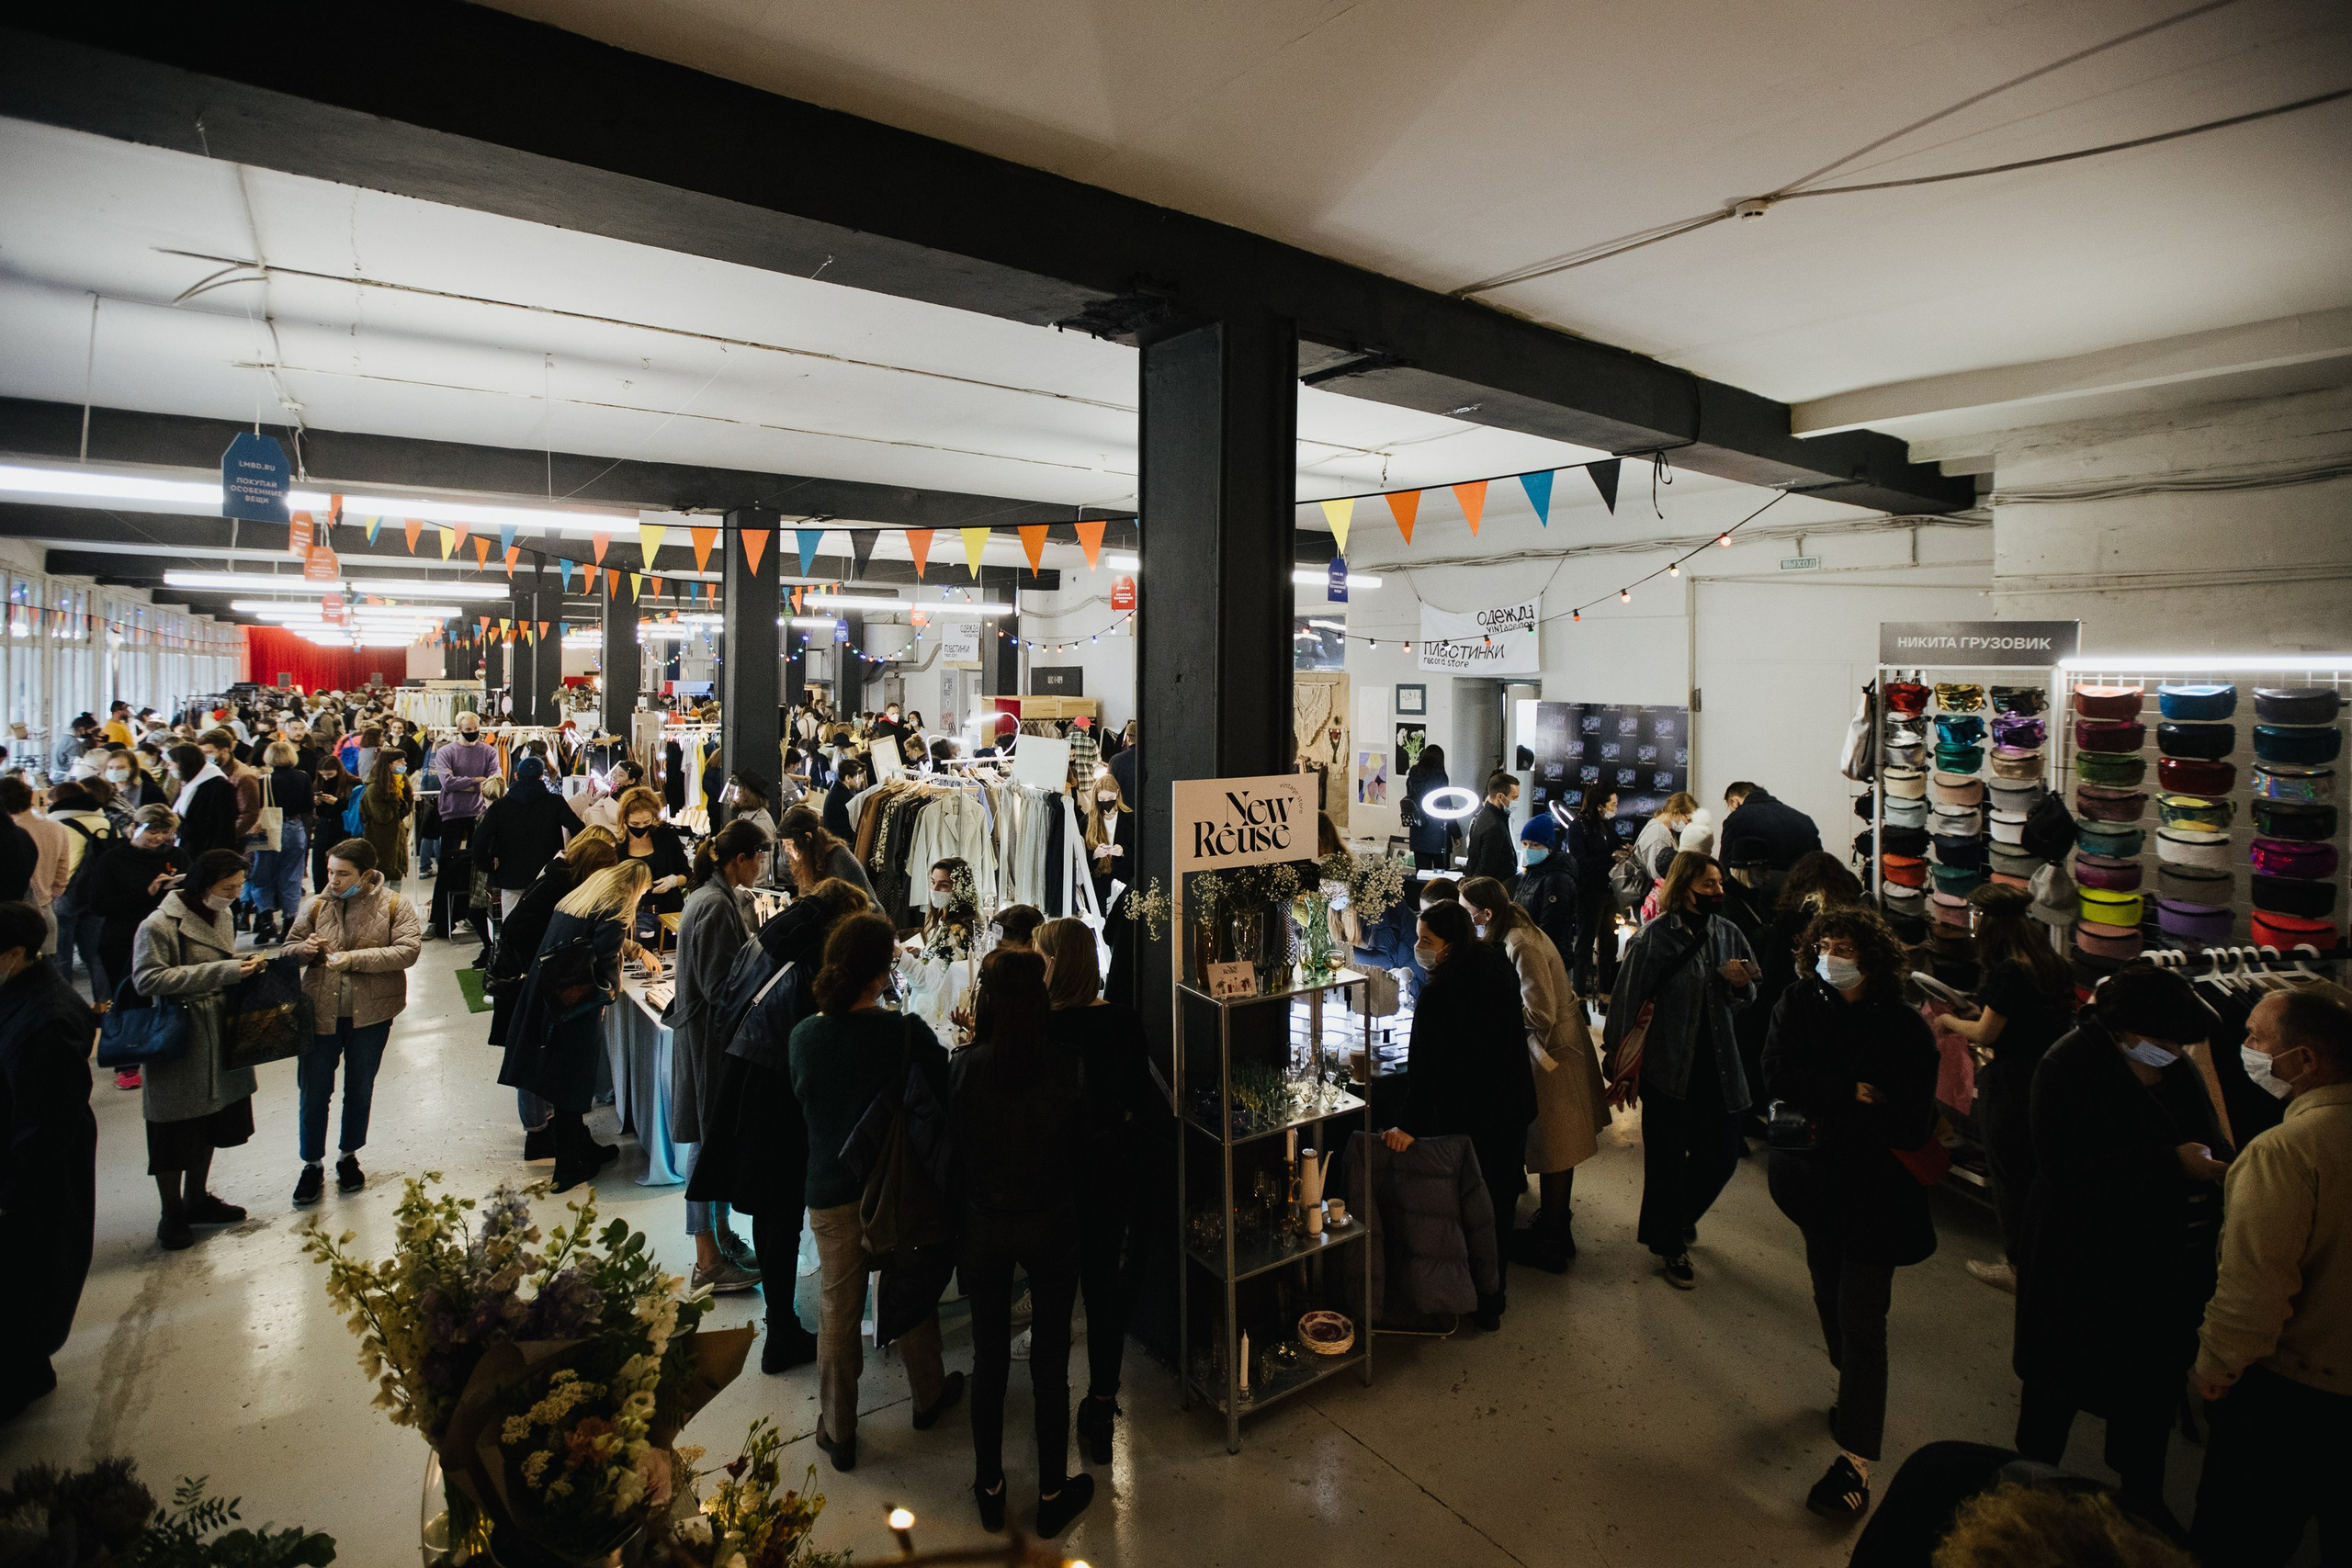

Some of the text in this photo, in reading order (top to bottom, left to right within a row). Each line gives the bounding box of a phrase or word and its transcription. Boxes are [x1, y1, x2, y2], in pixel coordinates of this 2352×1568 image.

[239, 460, 276, 471] LMBD.RU
[236, 478, 277, 488] ПОКУПАЙ
[230, 485, 284, 497] ОСОБЕННЫЕ
[244, 495, 269, 503] ВЕЩИ
[1782, 559, 1815, 569] ВЫХОД
[1898, 637, 2052, 649] НИКИТА ГРУЗОВИК
[1423, 657, 1469, 668] record store
[1279, 782, 1299, 795] vintage
[1224, 791, 1295, 828] New
[1193, 821, 1292, 858] Reuse
